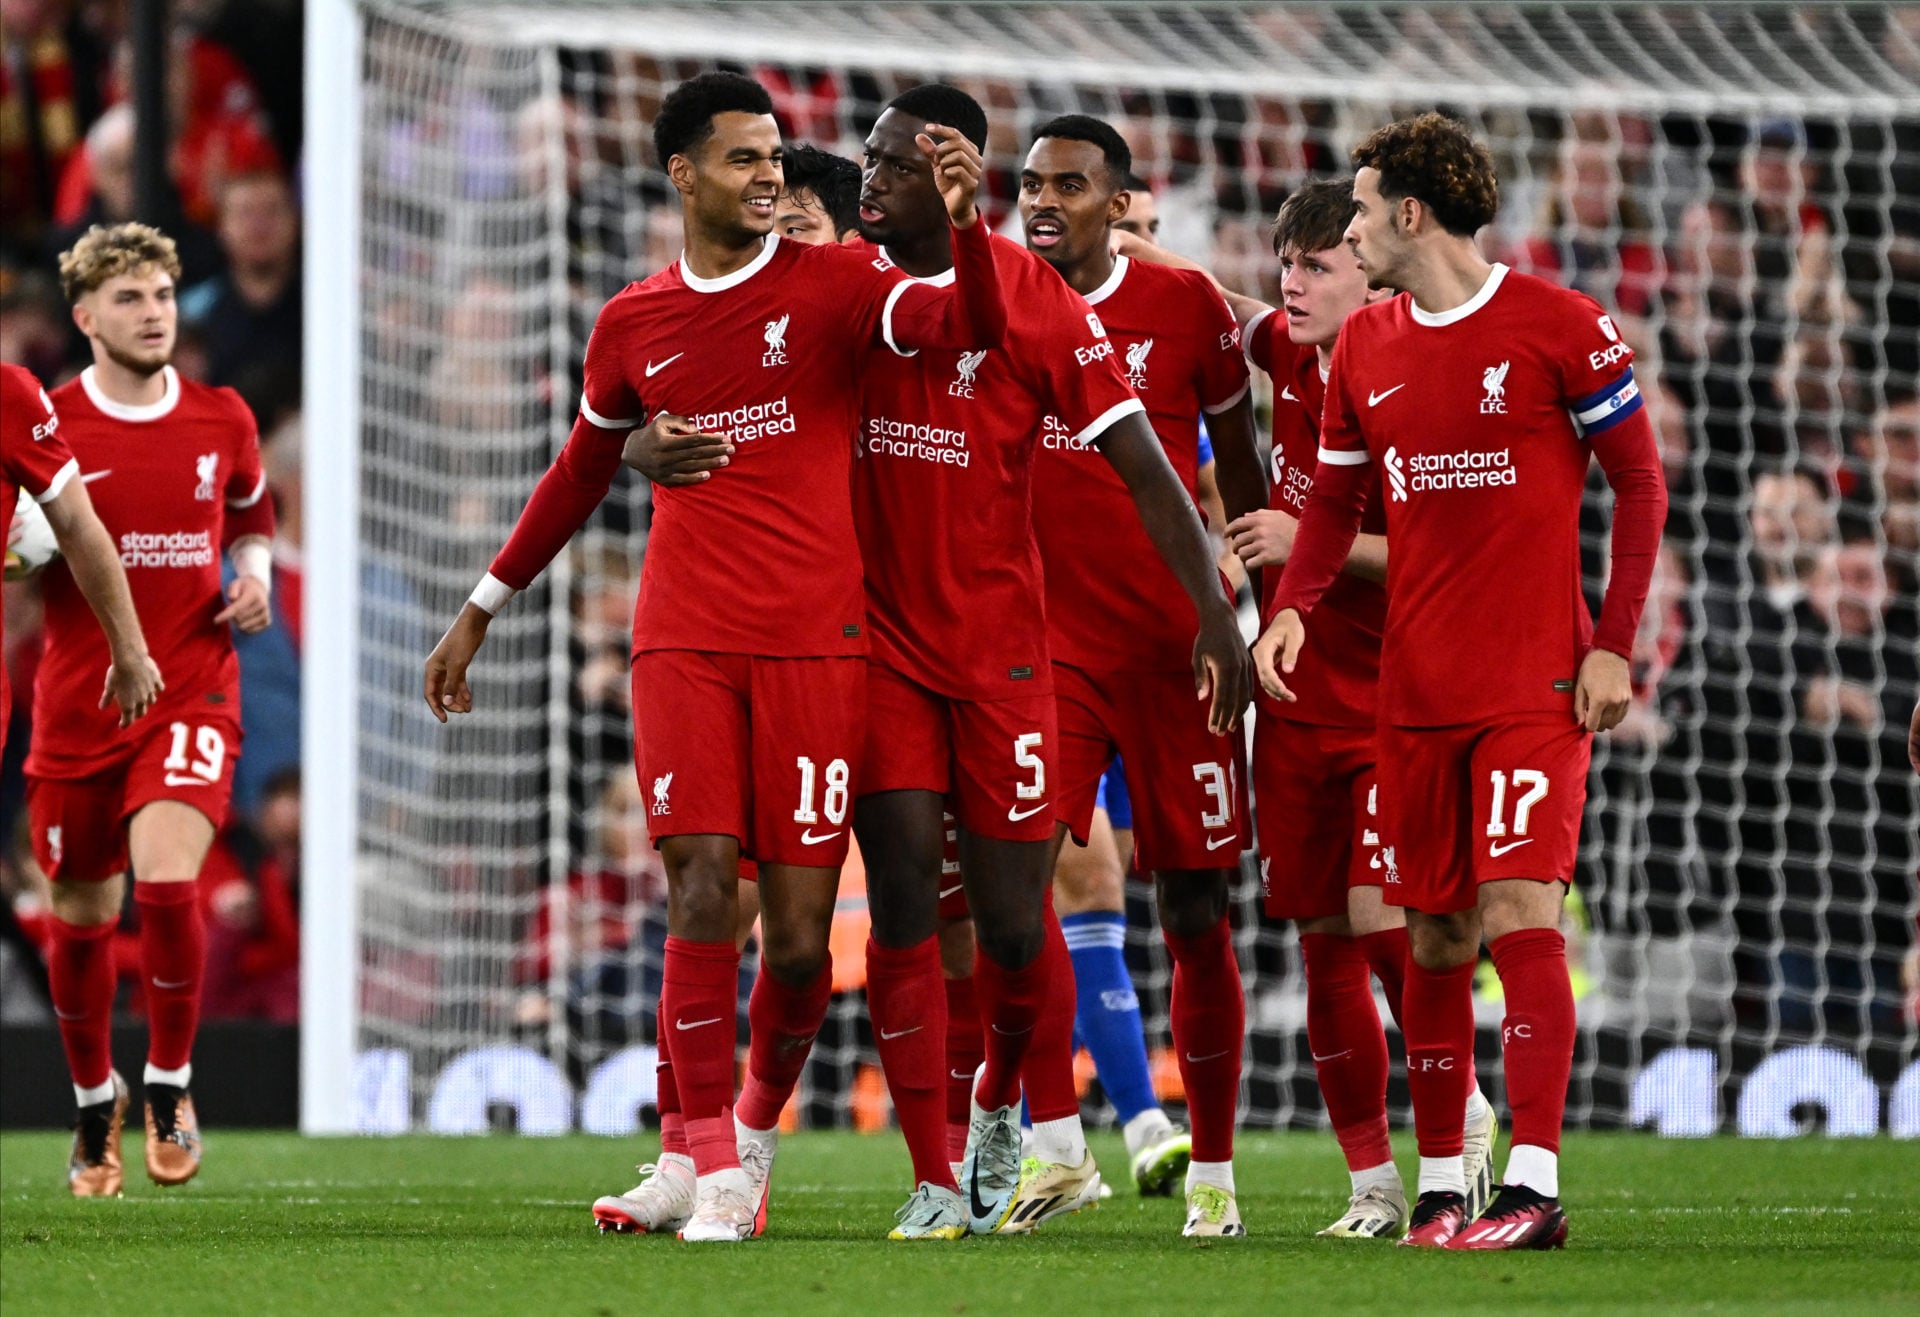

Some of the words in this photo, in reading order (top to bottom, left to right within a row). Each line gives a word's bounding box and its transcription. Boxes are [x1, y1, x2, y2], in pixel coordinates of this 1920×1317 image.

[869, 416, 965, 447] standard
[868, 437, 970, 468] chartered
[1409, 448, 1510, 473] standard
[1411, 466, 1517, 491] chartered
[120, 530, 208, 550] standard
[120, 547, 213, 568] chartered
[163, 721, 226, 783] 19
[1014, 732, 1046, 800] 5
[793, 756, 850, 826] 18
[1486, 769, 1550, 837] 17
